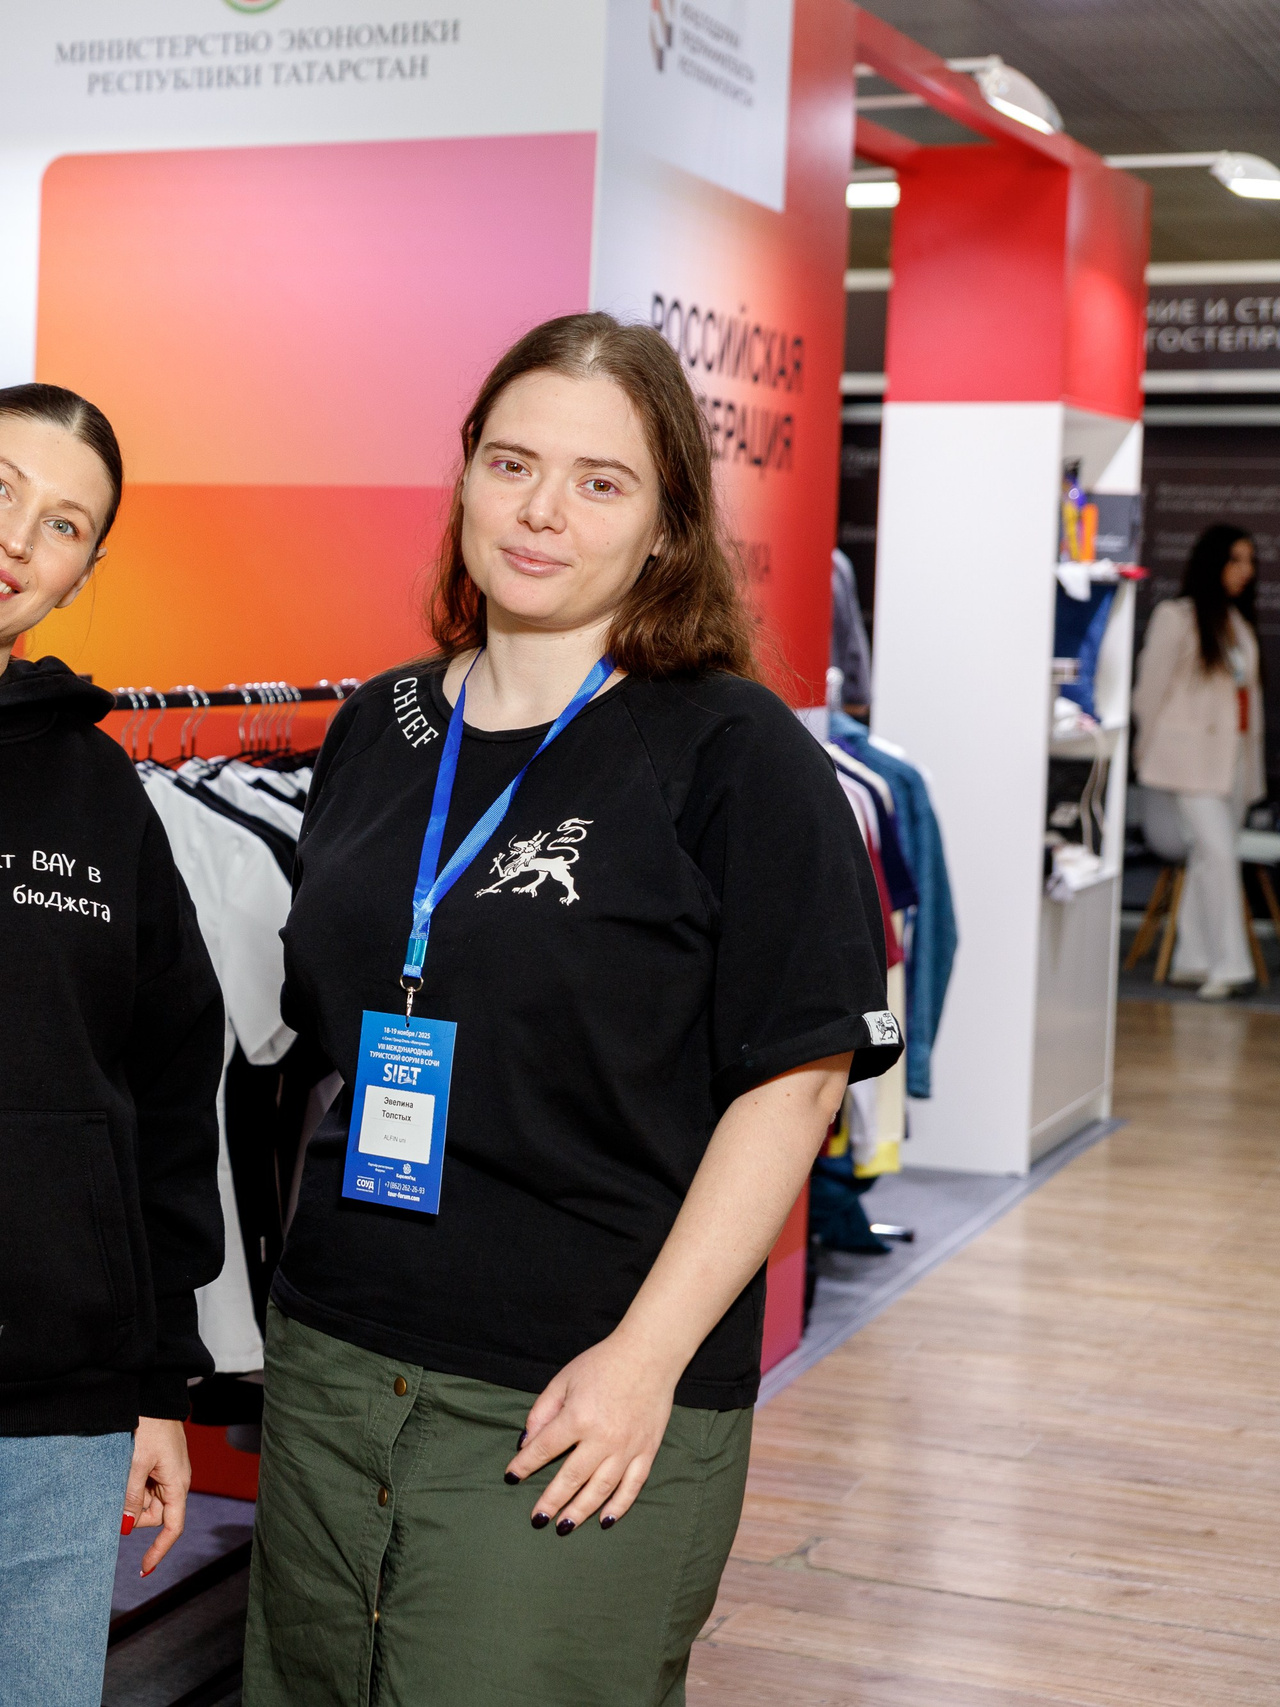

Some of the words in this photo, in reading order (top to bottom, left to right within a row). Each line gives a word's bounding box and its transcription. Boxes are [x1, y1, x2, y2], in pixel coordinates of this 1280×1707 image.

[54, 30, 272, 65] МИНИСТЕРСТВО
[278, 19, 461, 51] ЭКОНОМИКИ
[87, 63, 262, 96] РЕСПУБЛИКИ
[271, 55, 430, 87] ТАТАРСТАН
[651, 294, 806, 393] РОССИЙСКАЯ
[1144, 325, 1280, 353] ГОСТЕПР
[393, 677, 439, 748] CHIEF
[13, 884, 111, 923] бюджета
[384, 1027, 396, 1035] 18-19
[369, 1051, 401, 1061] ТУРИСТСКИЙ
[401, 1055, 420, 1065] ФОРУМ
[424, 1059, 440, 1067] СОЧИ
[386, 1044, 433, 1056] МЕЖДУНАРОДНЫЙ
[383, 1096, 414, 1109] Эвелина
[382, 1109, 412, 1122] Толстых
[357, 1179, 374, 1190] СОУД
